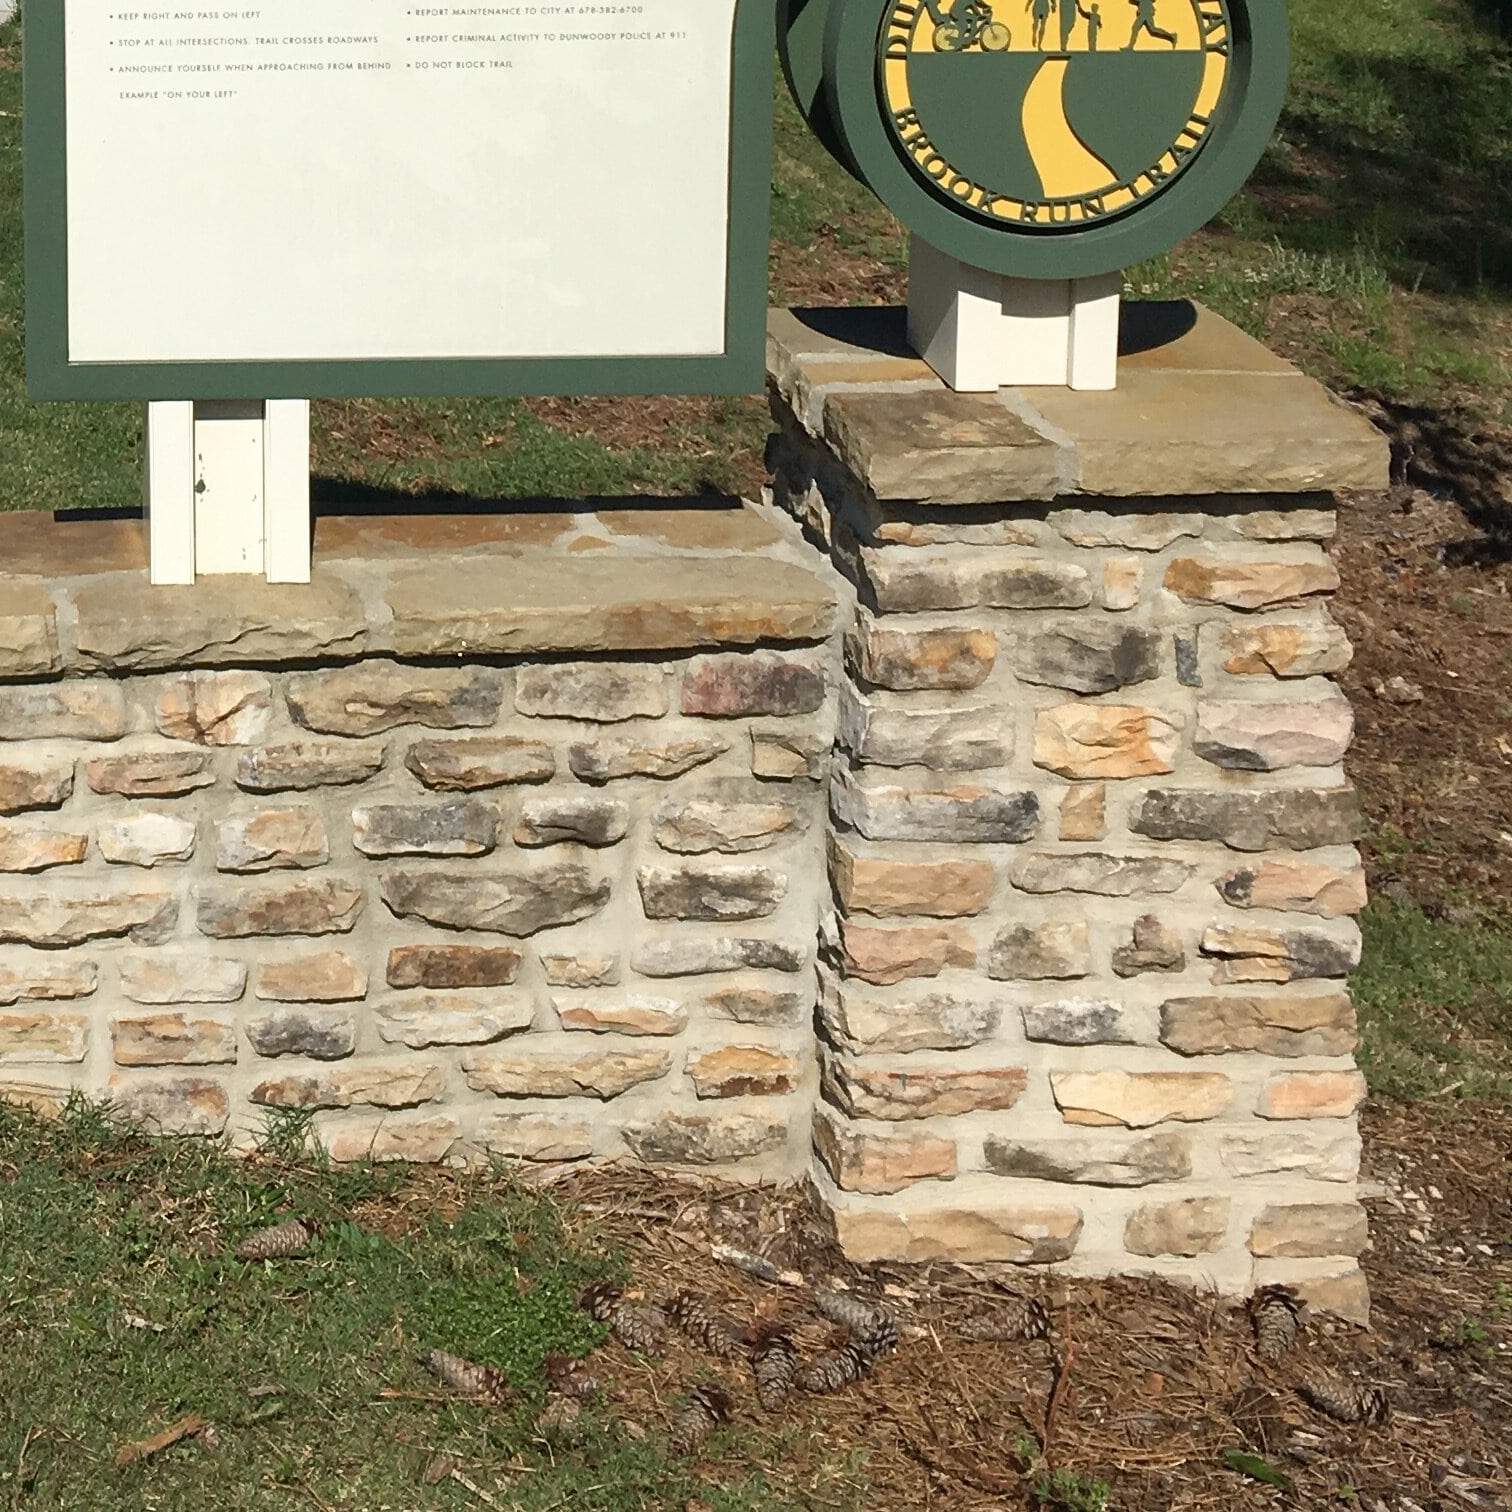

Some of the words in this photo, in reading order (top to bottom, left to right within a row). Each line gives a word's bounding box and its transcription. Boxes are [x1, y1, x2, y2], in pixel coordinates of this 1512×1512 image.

[118, 12, 140, 21] KEEP
[143, 11, 170, 21] RIGHT
[174, 11, 194, 20] AND
[198, 11, 219, 20] PASS
[223, 11, 238, 20] ON
[242, 10, 261, 19] LEFT
[416, 8, 449, 17] REPORT
[452, 7, 521, 16] MAINTENANCE
[524, 7, 537, 16] TO
[540, 6, 561, 15] CITY
[564, 6, 576, 15] AT
[118, 38, 141, 47] STOP
[144, 38, 155, 47] AT
[159, 38, 173, 47] ALL
[255, 37, 279, 46] TRAIL
[282, 36, 324, 45] CROSSES
[328, 36, 379, 45] ROADWAYS
[416, 34, 449, 43] REPORT
[452, 34, 496, 43] CRIMINAL
[500, 33, 540, 42] ACTIVITY
[544, 33, 556, 42] TO
[559, 32, 616, 42] DUNWOODY
[620, 32, 651, 41] POLICE
[655, 31, 666, 40] AT
[670, 31, 687, 40] 911
[118, 64, 173, 73] ANNOUNCE
[177, 63, 222, 73] YOURSELF
[225, 63, 254, 72] WHEN
[257, 62, 324, 72] APPROACHING
[328, 62, 354, 71] FROM
[358, 61, 392, 71] BEHIND
[415, 61, 429, 70] DO
[432, 61, 453, 70] NOT
[456, 61, 486, 70] BLOCK
[489, 60, 513, 69] TRAIL
[120, 91, 159, 100] EXAMPLE
[186, 90, 211, 99] YOUR
[894, 105, 1003, 218] BROOK
[1019, 195, 1107, 224] RUN
[1125, 109, 1217, 199] TRAIL
